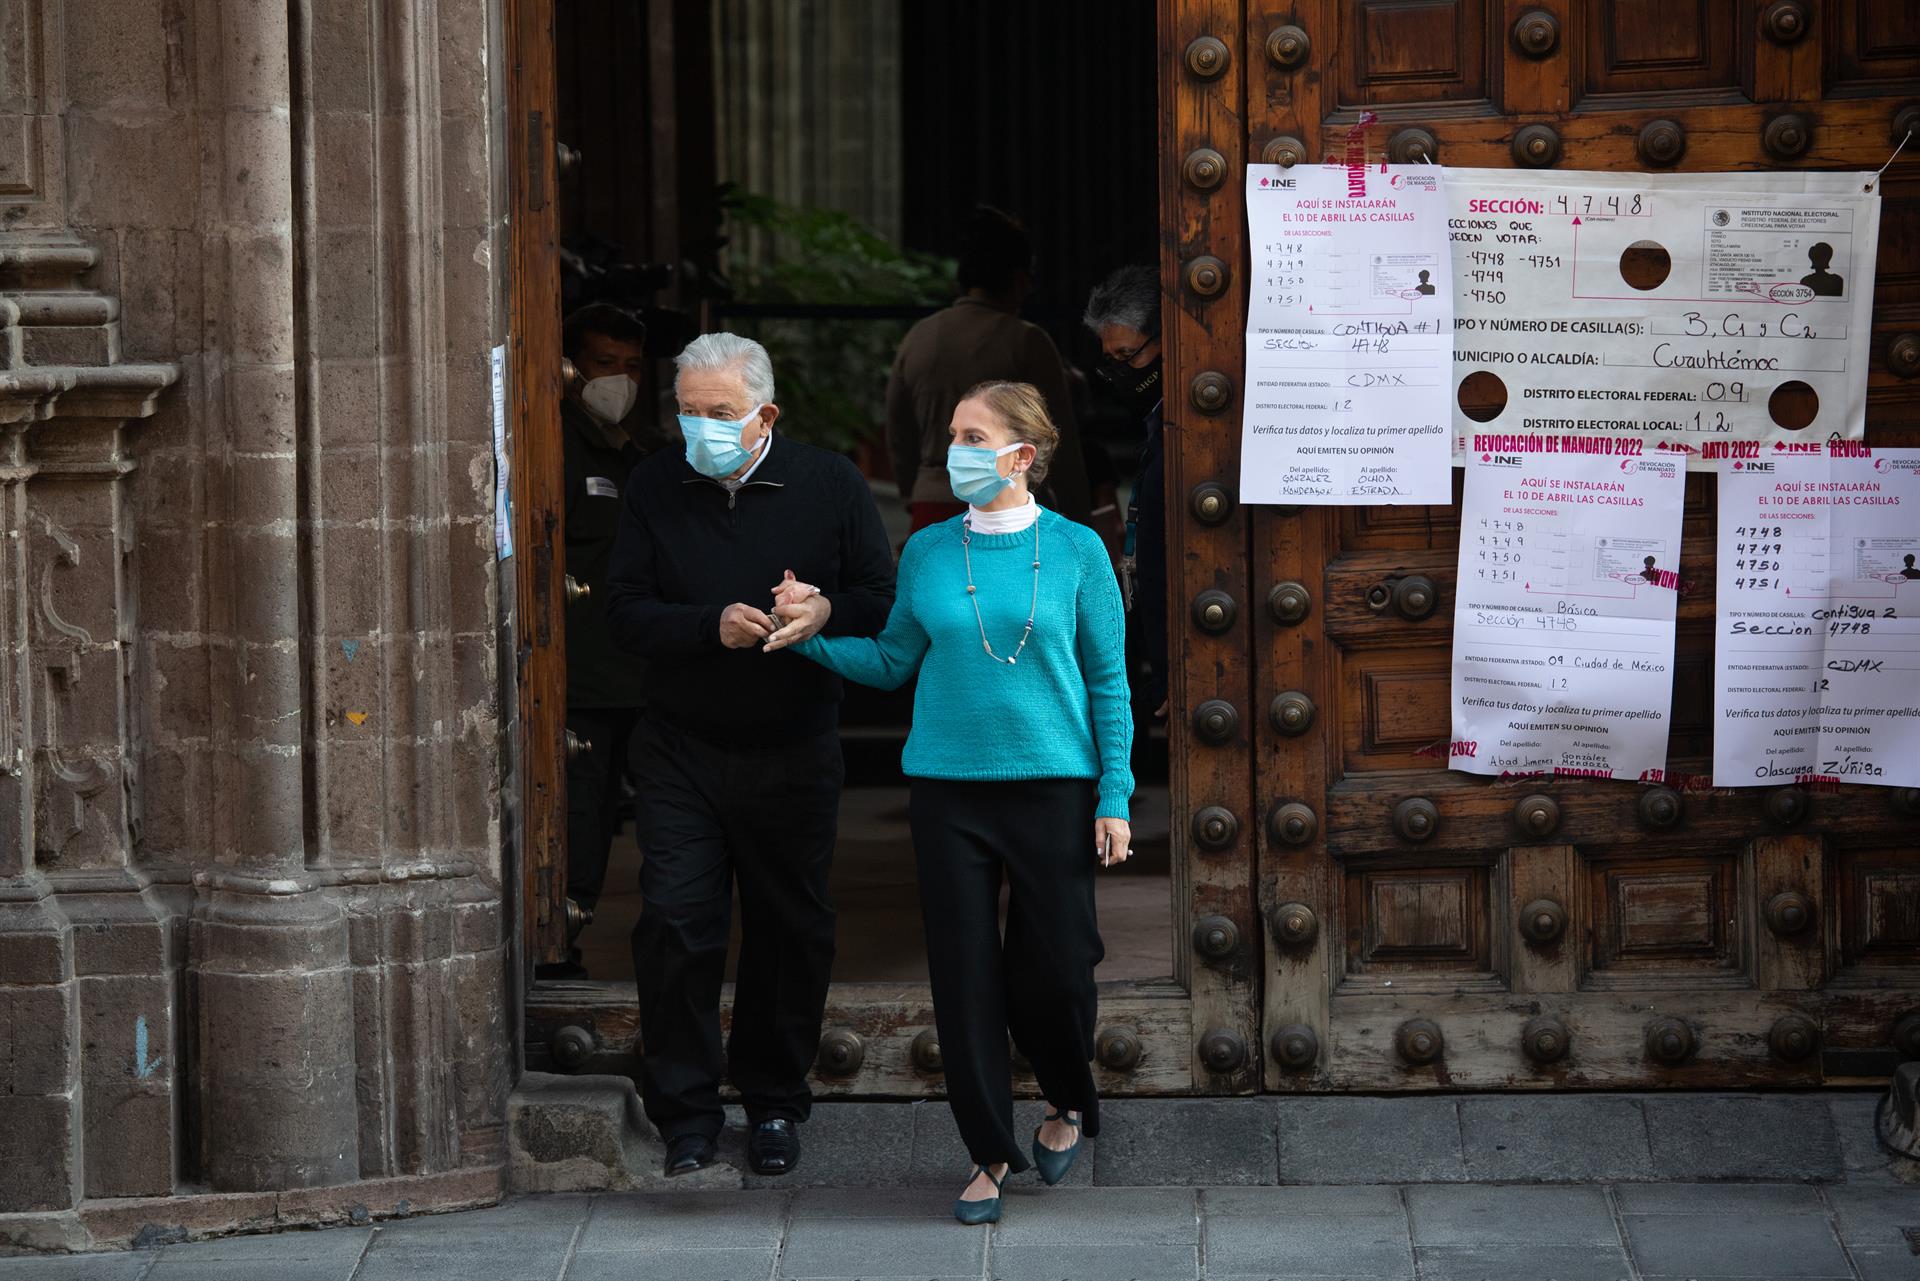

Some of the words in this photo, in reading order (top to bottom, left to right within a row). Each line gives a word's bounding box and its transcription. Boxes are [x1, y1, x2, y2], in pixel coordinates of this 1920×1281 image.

[1271, 179, 1297, 188] INE
[1296, 198, 1320, 209] AQUÍ
[1322, 200, 1333, 209] SE
[1335, 198, 1396, 209] INSTALARÁN
[1469, 198, 1544, 214] SECCIÓN:
[1283, 214, 1292, 222] EL
[1294, 213, 1305, 222] 10
[1307, 213, 1318, 222] DE
[1320, 213, 1346, 222] ABRIL
[1350, 213, 1367, 222] LAS
[1370, 212, 1415, 222] CASILLAS
[1448, 218, 1498, 230] ECCIONES
[1509, 221, 1533, 231] QUE
[1496, 234, 1542, 244] VOTAR:
[1795, 288, 1812, 298] 3754
[1452, 318, 1476, 330] IPO
[1478, 320, 1488, 330] Y
[1490, 318, 1547, 332] NÚMERO
[1550, 321, 1568, 333] DE
[1570, 321, 1644, 336] CASILLA(S):
[1517, 353, 1528, 364] O
[1530, 351, 1599, 366] ALCALDÍA:
[1653, 342, 1779, 371] Cuauhtémoc
[1134, 370, 1160, 394] SHCP
[1347, 373, 1407, 387] CDMX
[1523, 389, 1575, 399] DISTRITO
[1578, 390, 1641, 400] ELECTORAL
[1644, 392, 1696, 402] FEDERAL:
[1523, 418, 1575, 429] DISTRITO
[1577, 419, 1641, 430] ELECTORAL
[1644, 420, 1682, 430] LOCAL:
[1252, 425, 1284, 435] Verifica
[1285, 426, 1298, 434] tus
[1299, 425, 1323, 435] datos
[1324, 428, 1330, 437] y
[1331, 425, 1366, 436] localiza
[1367, 426, 1376, 436] tu
[1377, 426, 1406, 438] primer
[1408, 426, 1444, 437] apellido
[1296, 446, 1317, 455] AQUÍ
[1317, 447, 1347, 455] EMITEN
[1348, 447, 1359, 455] SU
[1360, 446, 1394, 455] OPINIÓN
[1474, 432, 1543, 453] REVOCACIÓN
[1545, 436, 1560, 453] DE
[1561, 436, 1612, 455] MANDATO
[1614, 437, 1643, 456] 2022
[1731, 441, 1759, 459] 2022
[1789, 443, 1821, 453] INE
[1494, 455, 1522, 465] INE
[1746, 462, 1775, 471] INE
[1369, 466, 1398, 474] apellido:
[1520, 477, 1547, 488] AQUÍ
[1550, 480, 1561, 489] SE
[1563, 480, 1625, 492] INSTALARÁN
[1775, 481, 1801, 492] AQUÍ
[1804, 483, 1816, 492] SE
[1818, 480, 1880, 492] INSTALARÁN
[1503, 490, 1515, 499] EL
[1518, 491, 1529, 500] 10
[1531, 492, 1544, 501] DE
[1546, 492, 1574, 503] ABRIL
[1577, 494, 1594, 504] LAS
[1597, 495, 1644, 507] CASILLAS
[1759, 496, 1769, 505] EL
[1772, 496, 1784, 505] 10
[1787, 496, 1800, 505] DE
[1802, 496, 1831, 505] ABRIL
[1833, 496, 1851, 506] LAS
[1853, 496, 1900, 506] CASILLAS
[1557, 600, 1599, 617] Básica
[1811, 605, 1876, 621] Contigua
[1882, 608, 1898, 619] 2
[1574, 656, 1608, 670] Ciudad
[1612, 659, 1623, 670] de
[1631, 660, 1665, 672] México
[1827, 659, 1884, 672] CDMX
[1461, 696, 1495, 708] Verifica
[1496, 700, 1510, 710] tus
[1512, 701, 1536, 713] datos
[1538, 705, 1544, 715] y
[1545, 704, 1580, 715] localiza
[1581, 706, 1591, 715] tu
[1592, 708, 1624, 719] primer
[1624, 708, 1662, 720] apellido
[1725, 708, 1760, 718] Verifica
[1761, 709, 1775, 718] tus
[1776, 708, 1801, 718] datos
[1802, 710, 1808, 720] y
[1809, 705, 1841, 717] localiza
[1843, 708, 1852, 716] tu
[1854, 707, 1884, 718] primer
[1508, 721, 1529, 730] AQUÍ
[1529, 723, 1560, 731] EMITEN
[1561, 723, 1573, 731] SU
[1573, 724, 1609, 734] OPINIÓN
[1773, 727, 1794, 736] AQUÍ
[1794, 726, 1821, 735] EMITEN
[1822, 726, 1834, 734] SU
[1835, 726, 1871, 735] OPINIÓN
[1450, 741, 1477, 758] 2022
[1580, 742, 1611, 750] apellido:
[1843, 745, 1873, 753] apellido:
[1822, 755, 1883, 777] Zúñiga
